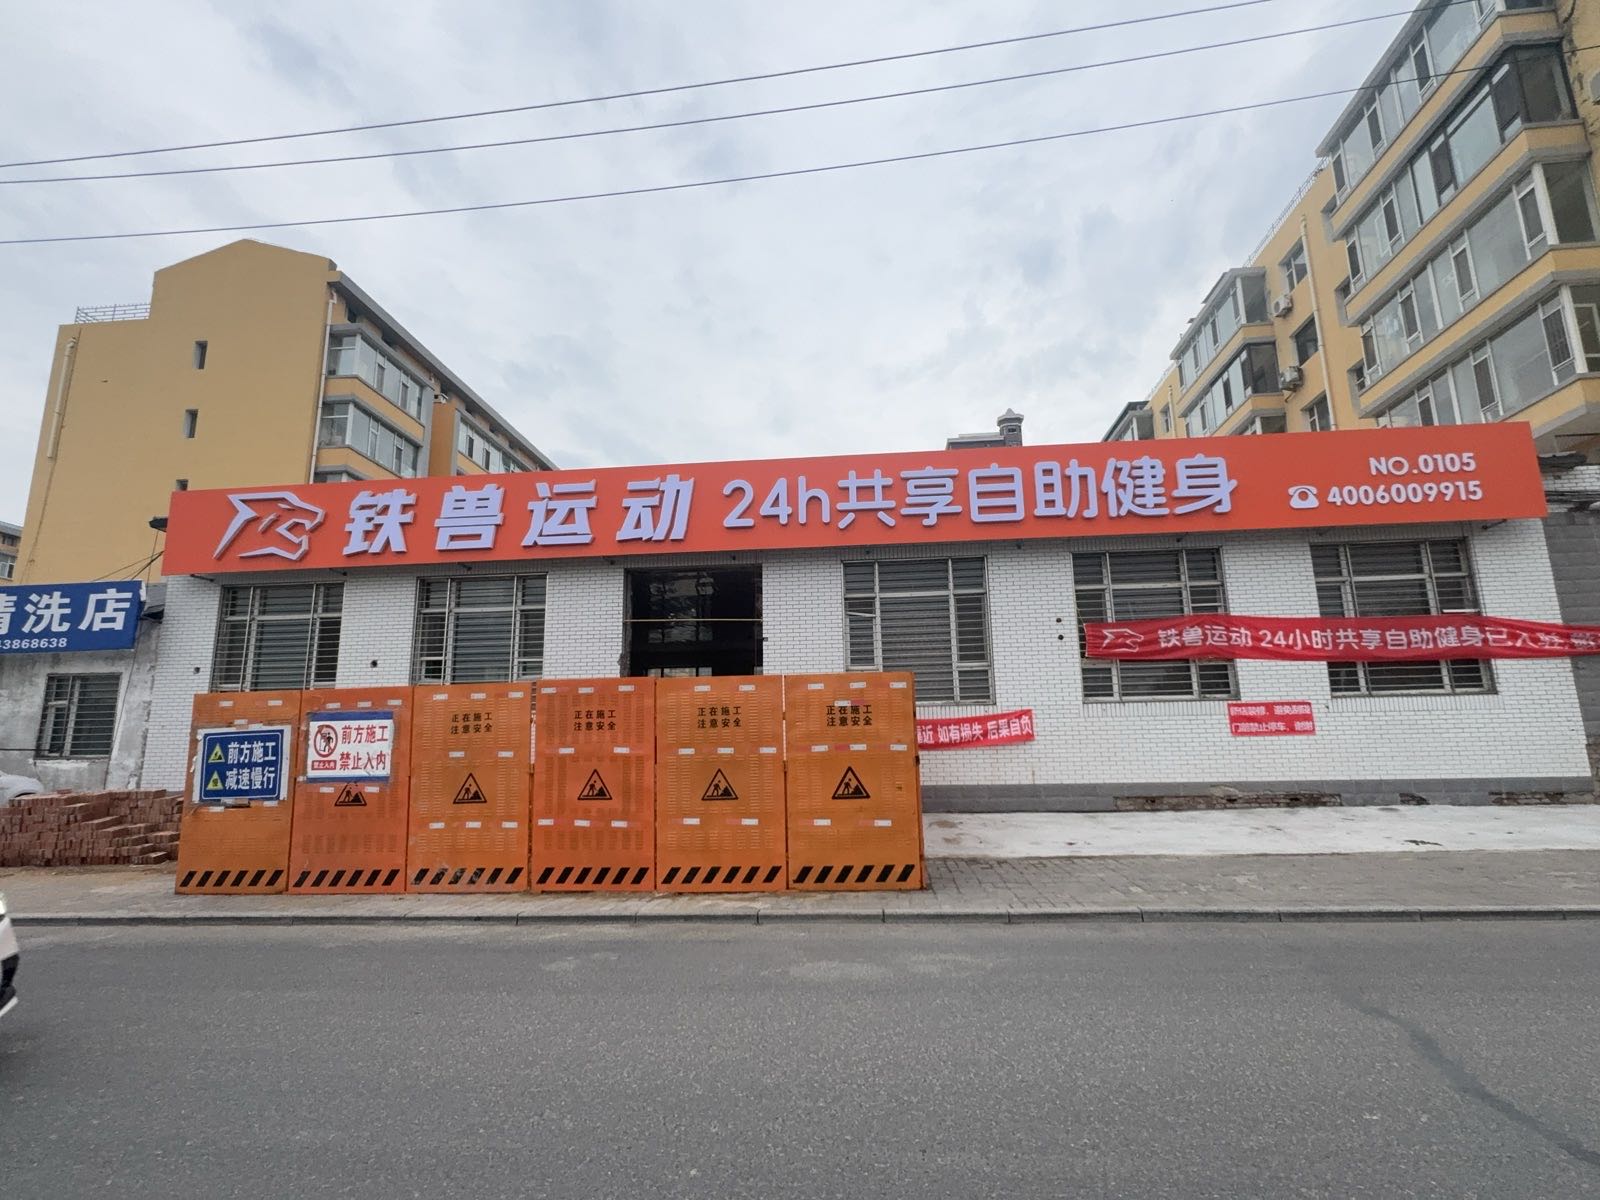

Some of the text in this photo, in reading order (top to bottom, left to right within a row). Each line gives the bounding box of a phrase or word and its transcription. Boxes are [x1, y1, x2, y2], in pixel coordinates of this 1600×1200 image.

[1368, 453, 1477, 476] NO.0105
[1326, 480, 1483, 506] 4006009915
[342, 453, 1238, 556] 铁兽运动 24h共享自助健身
[0, 637, 68, 650] 3868638
[1157, 624, 1252, 648] 铁兽运动
[451, 712, 493, 723] 正在施工
[574, 709, 617, 719] 正在施工
[697, 706, 742, 717] 正在施工
[826, 715, 873, 726] 注意安全
[450, 723, 493, 735] 注意安全
[573, 721, 617, 732] 注意安全
[697, 717, 742, 729] 注意安全
[937, 721, 984, 743] 如有损失
[986, 714, 1033, 740] 后果自负
[341, 724, 389, 744] 前方施工
[227, 741, 277, 764] 前方施工
[339, 750, 386, 771] 禁止入内
[225, 766, 276, 790] 减速慢行
